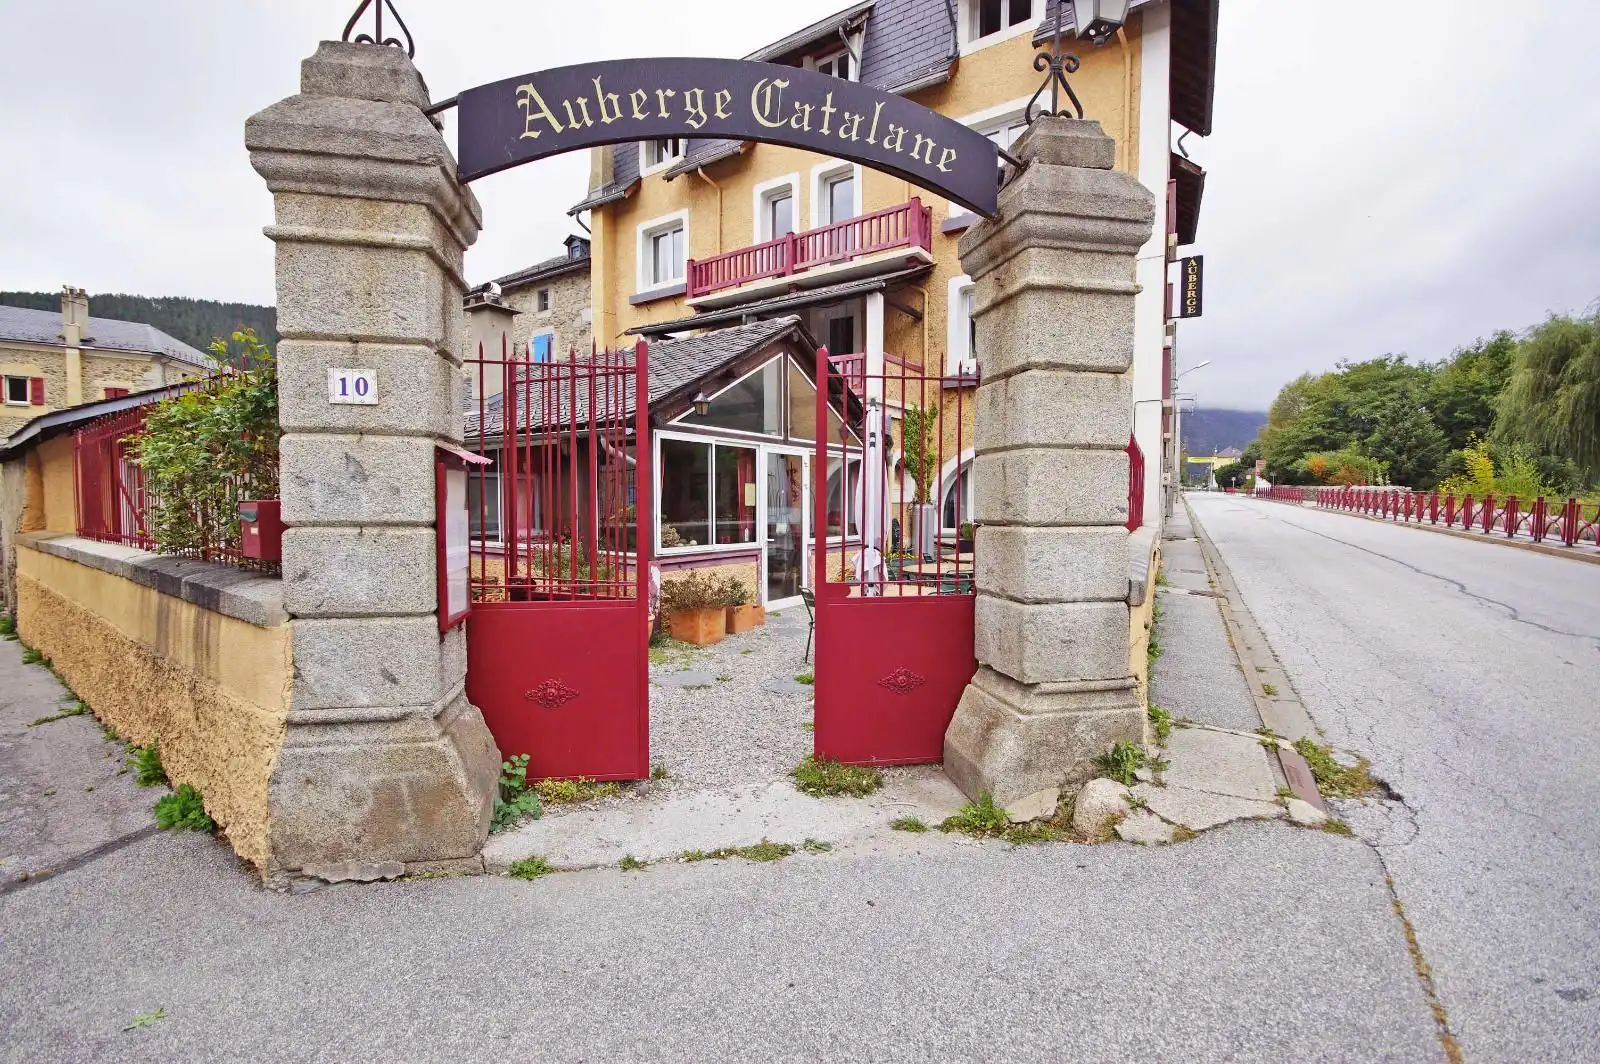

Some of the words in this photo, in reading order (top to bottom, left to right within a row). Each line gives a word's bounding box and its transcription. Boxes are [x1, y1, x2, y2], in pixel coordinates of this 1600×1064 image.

[515, 75, 733, 140] Auberge
[751, 77, 957, 173] Catalane
[1186, 258, 1198, 314] AUBERGE
[338, 376, 369, 397] 10
